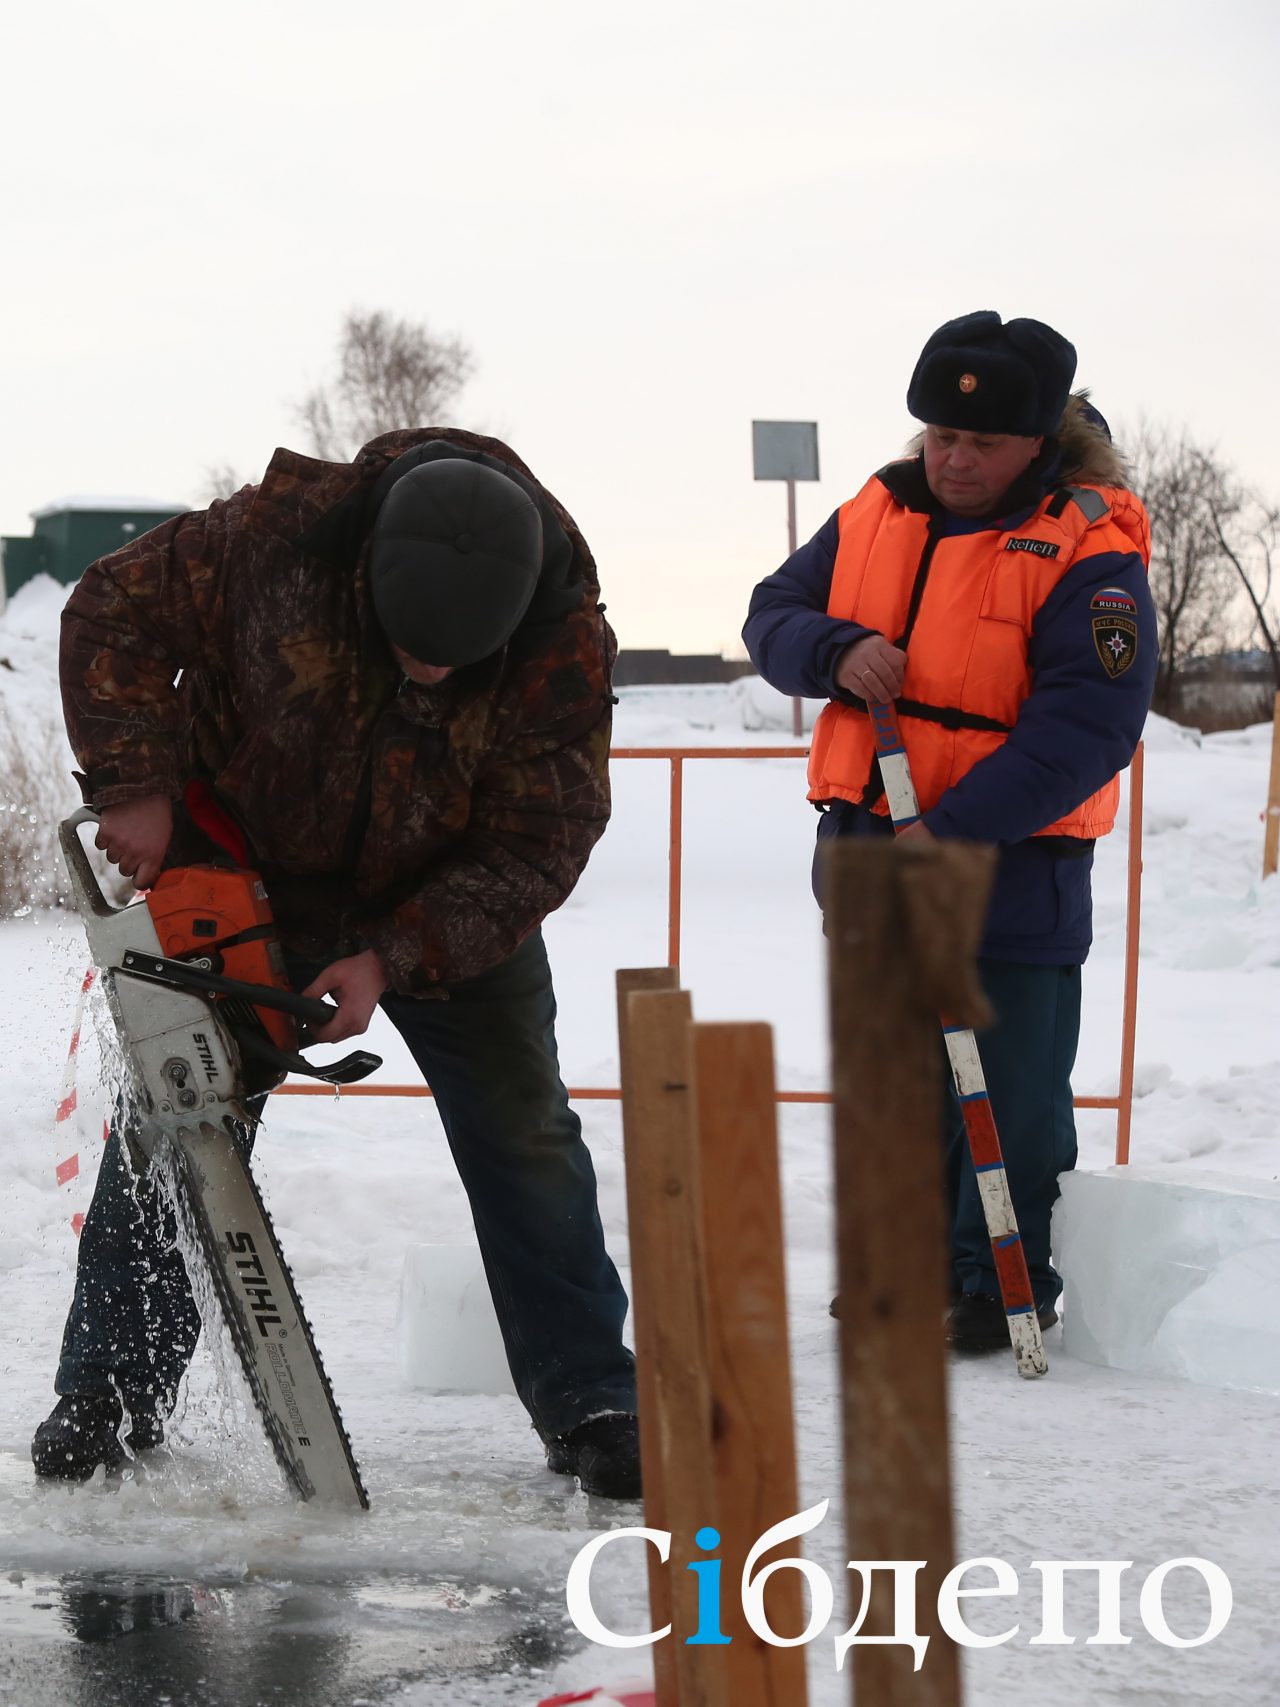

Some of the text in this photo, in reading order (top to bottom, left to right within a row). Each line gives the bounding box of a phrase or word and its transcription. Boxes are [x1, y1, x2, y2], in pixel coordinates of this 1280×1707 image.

[1099, 601, 1131, 611] RUSSIA
[192, 1033, 219, 1084] STIHL
[265, 1342, 311, 1447] ROLLOMATIC E
